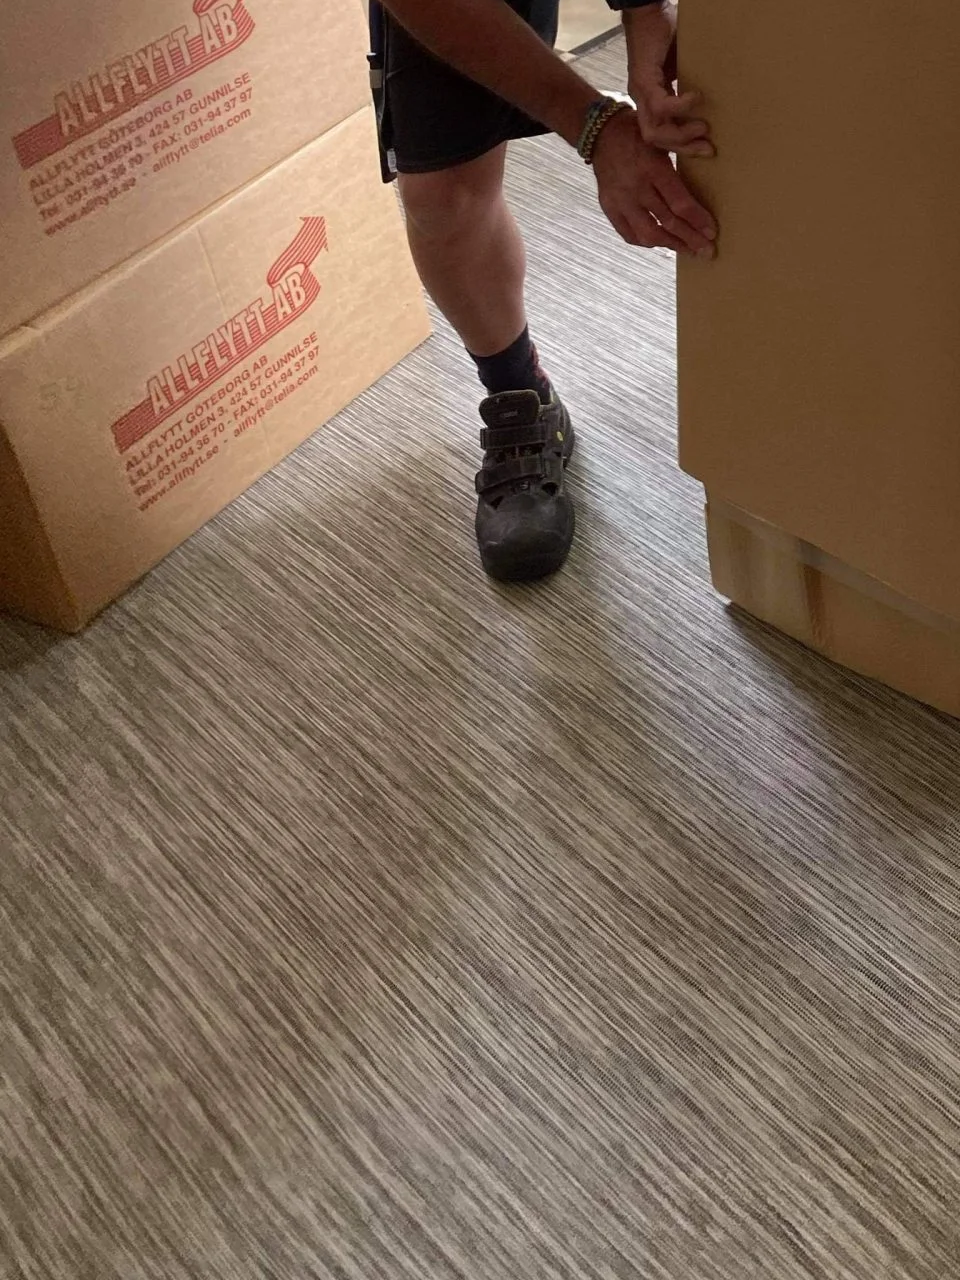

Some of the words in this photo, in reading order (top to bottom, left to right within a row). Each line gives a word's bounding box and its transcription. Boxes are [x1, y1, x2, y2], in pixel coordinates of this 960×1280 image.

[53, 26, 192, 136] ALLFLYTT
[200, 3, 239, 55] AB
[149, 120, 170, 138] 424
[172, 110, 185, 125] 57
[189, 72, 251, 114] GUNNILSE
[175, 88, 194, 106] AB
[184, 107, 221, 136] 031-94
[224, 97, 237, 112] 37
[239, 87, 253, 102] 97
[146, 298, 265, 416] ALLFLYTT
[272, 271, 306, 321] AB
[165, 413, 216, 457] HOLMEN
[230, 388, 248, 406] 424
[250, 376, 262, 390] 57
[264, 331, 318, 379] GUNNILSE
[211, 422, 225, 438] 70
[233, 396, 259, 420] FAX:
[260, 368, 293, 399] 031-94
[308, 345, 319, 360] 97
[126, 420, 184, 472] ALLFLYTT
[253, 355, 268, 374] AB
